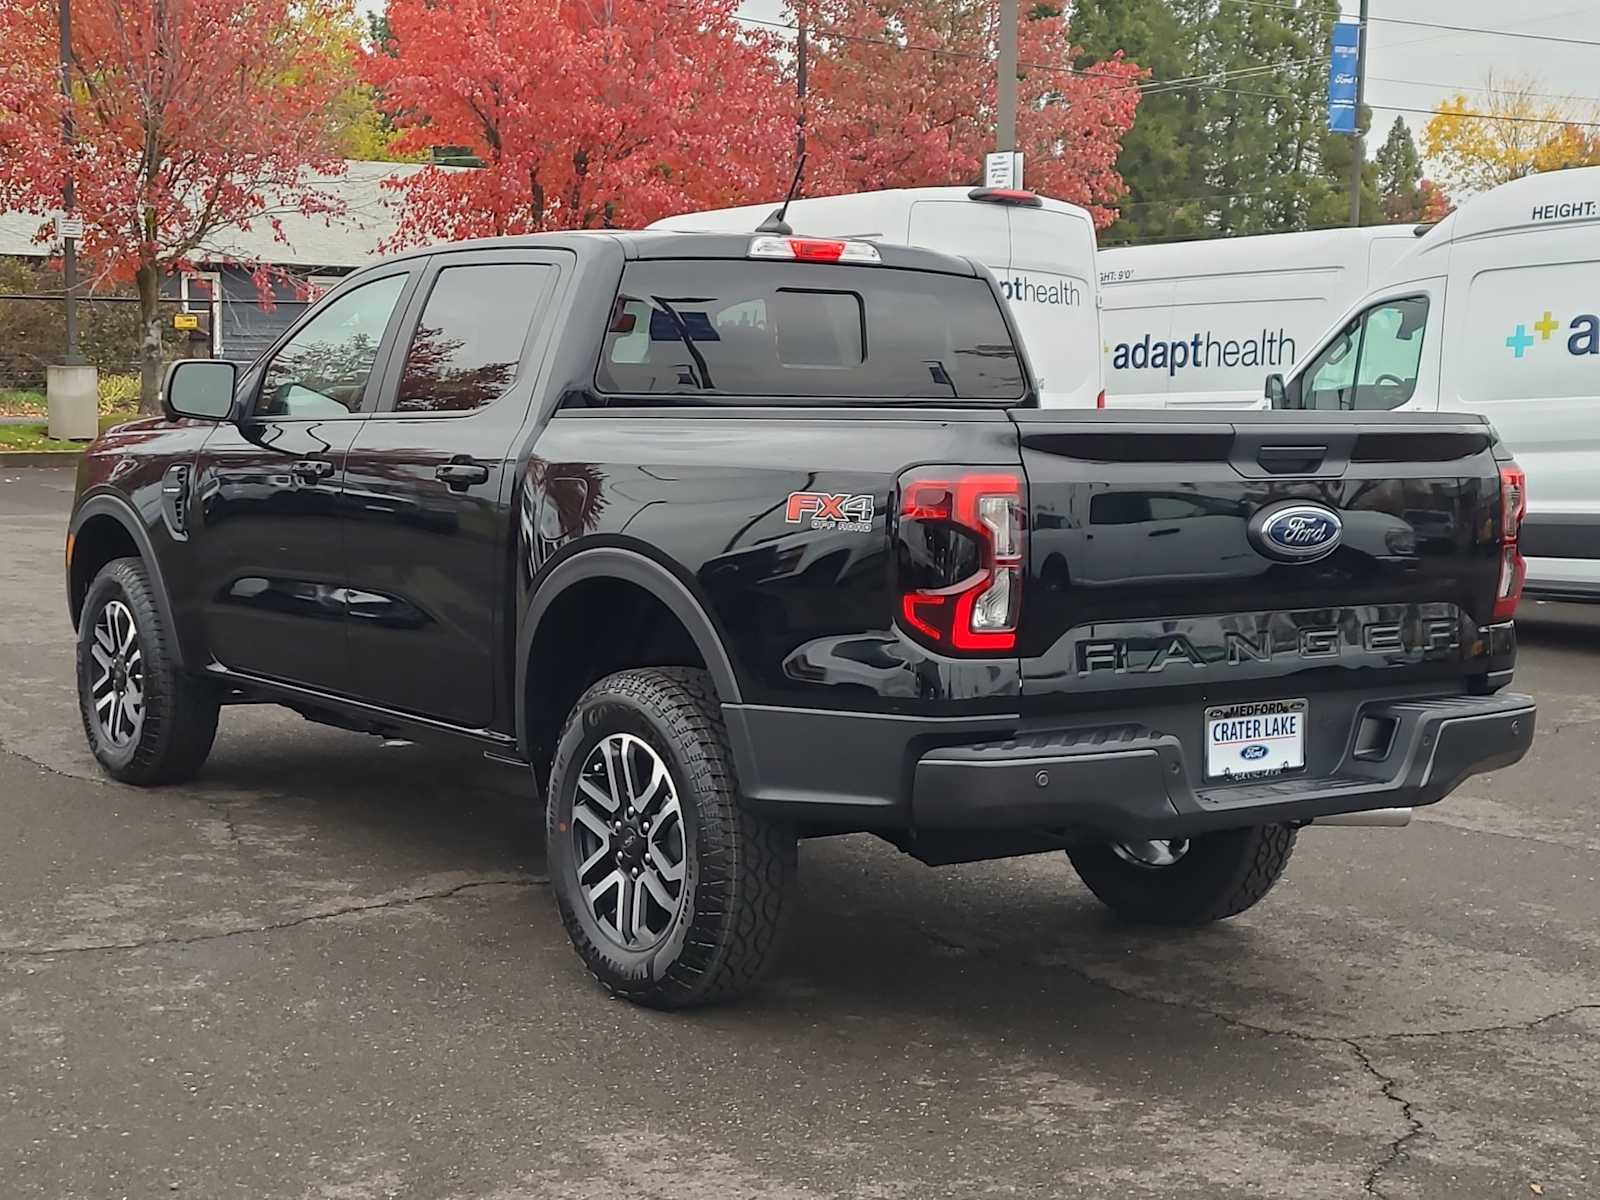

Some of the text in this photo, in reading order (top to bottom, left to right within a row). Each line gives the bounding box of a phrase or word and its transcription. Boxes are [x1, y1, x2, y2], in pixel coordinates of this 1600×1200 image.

[1531, 201, 1597, 220] HEIGHT:
[999, 276, 1080, 307] pthealth
[1113, 327, 1296, 377] adapthealth
[785, 491, 875, 523] FX4
[811, 520, 872, 532] OFF ROAD
[1283, 516, 1327, 543] Ford
[1075, 616, 1461, 678] RANGER
[1230, 702, 1283, 717] MEDFORD
[1213, 716, 1297, 742] CRATER LAKE
[1244, 746, 1266, 759] Ford
